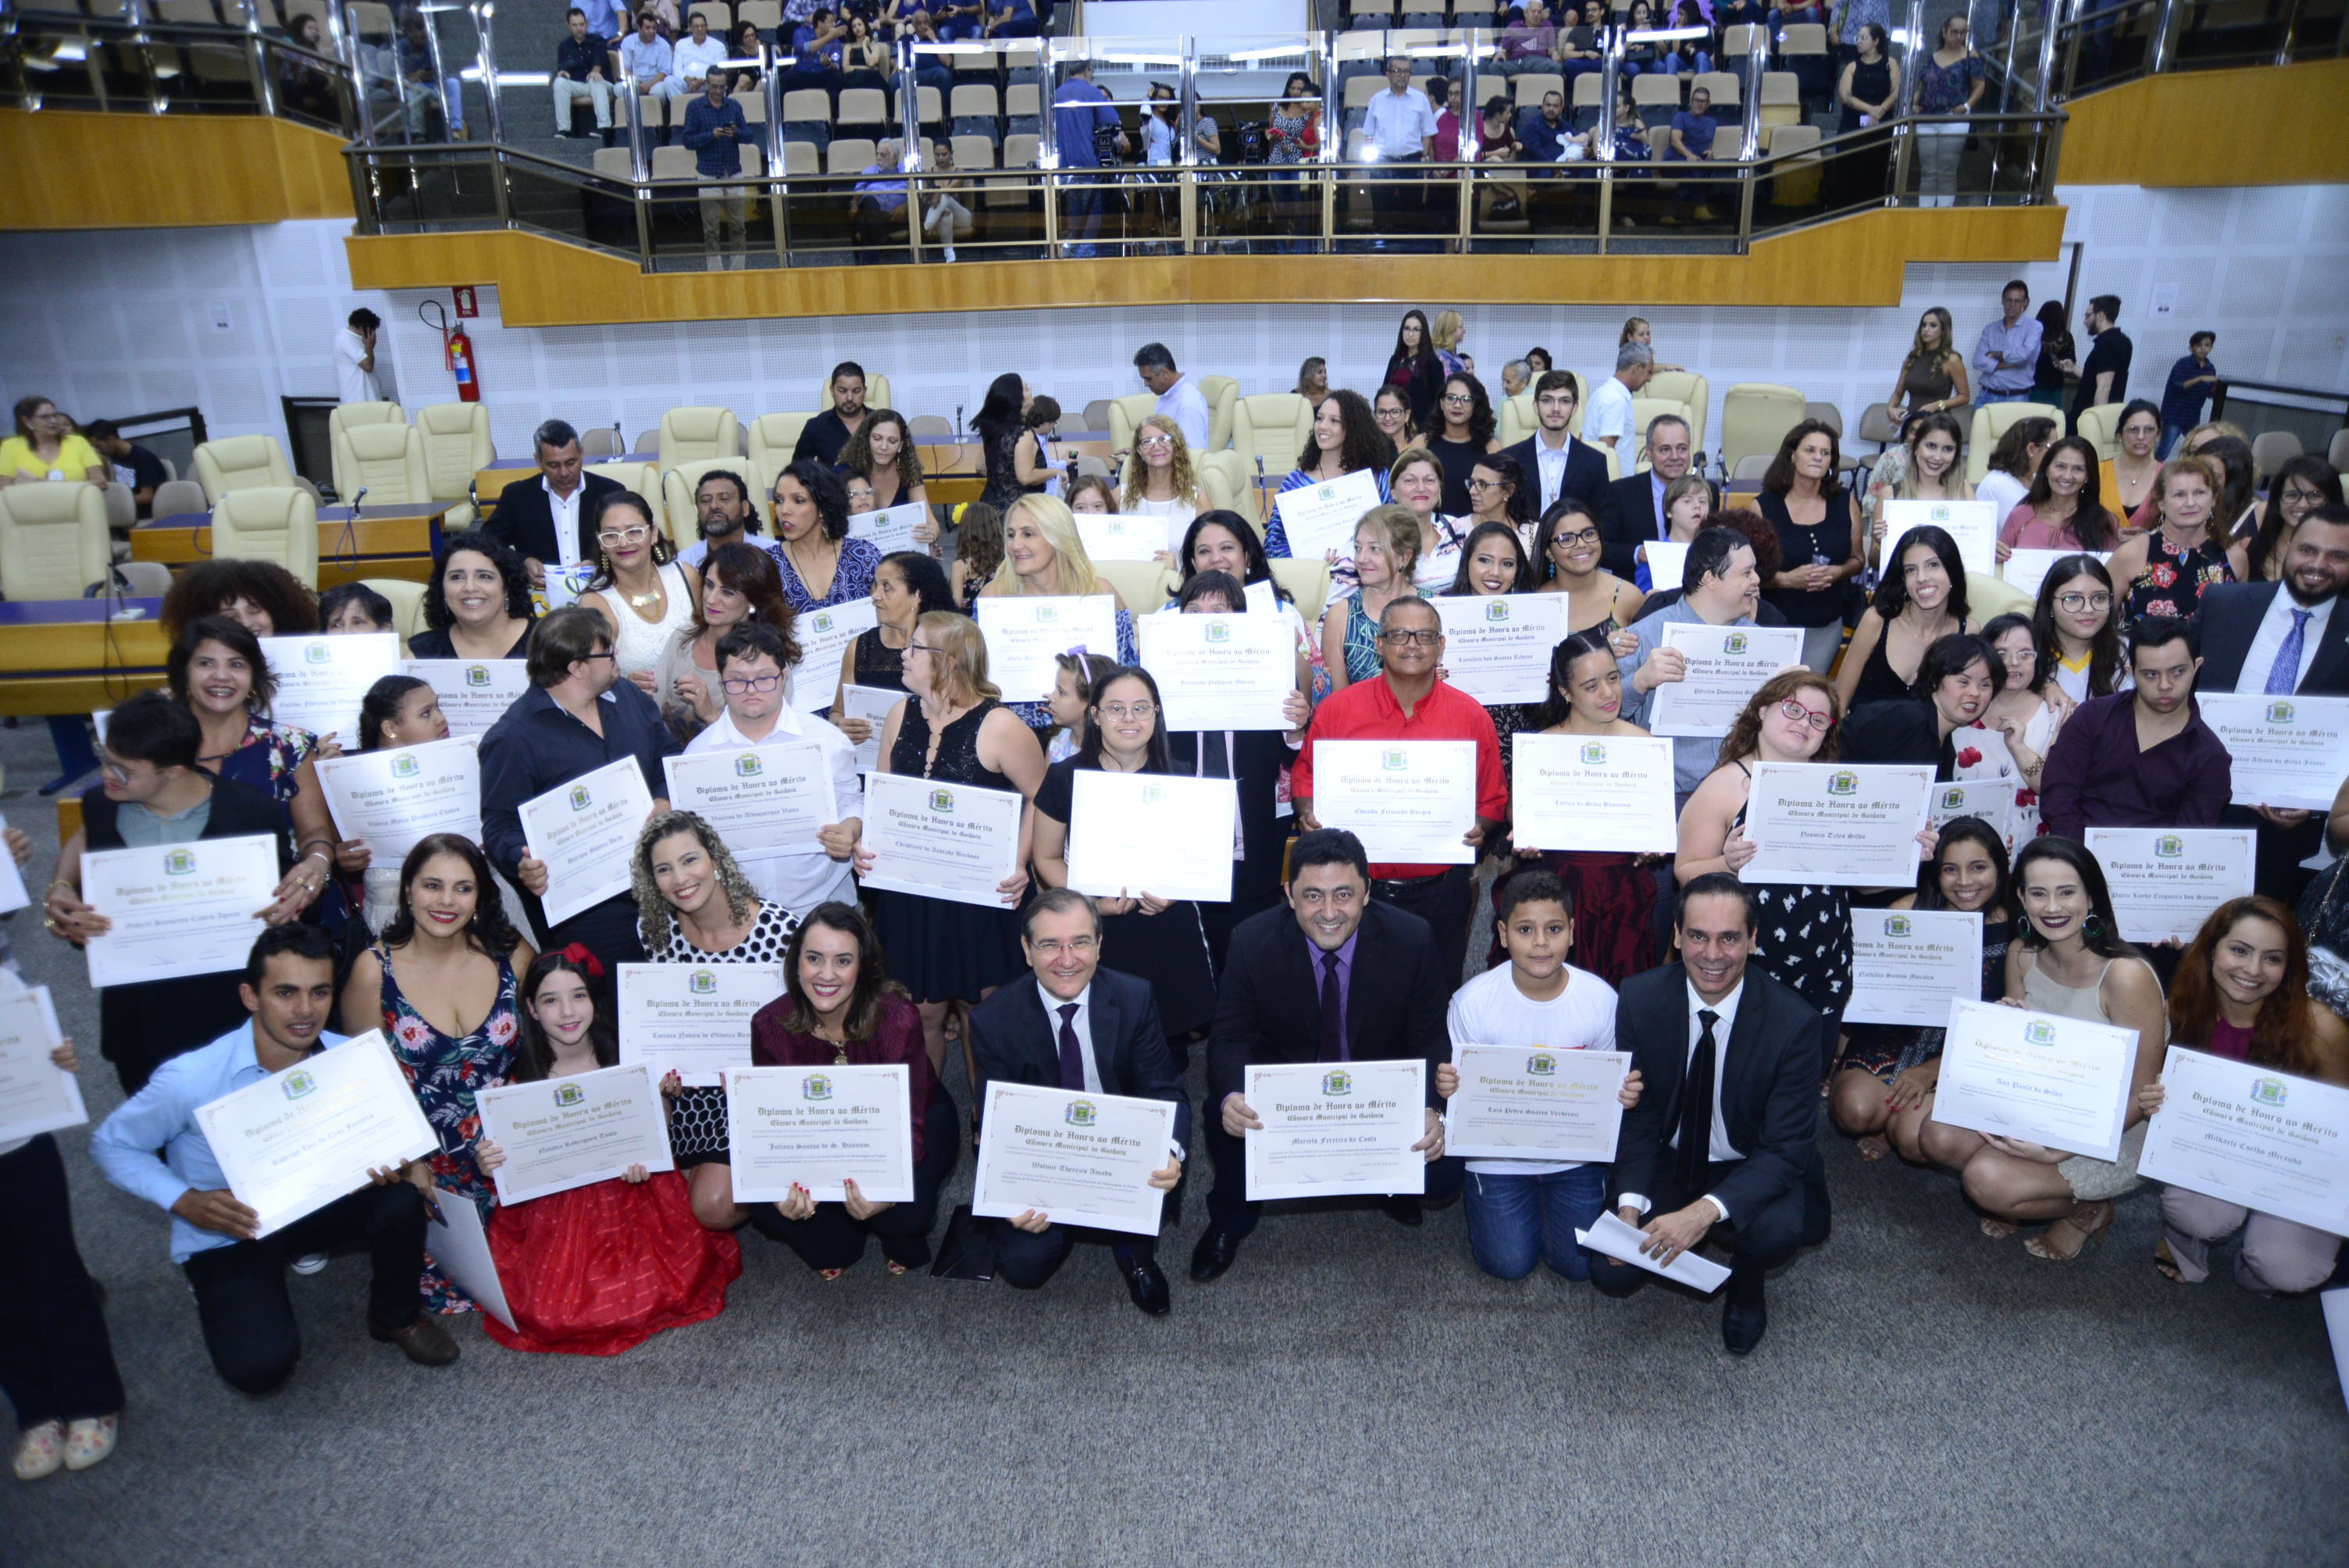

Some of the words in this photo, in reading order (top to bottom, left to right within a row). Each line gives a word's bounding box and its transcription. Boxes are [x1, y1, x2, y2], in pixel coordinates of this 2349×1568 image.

[1778, 799, 1813, 807] Diploma
[1829, 800, 1855, 809] Honra
[889, 809, 918, 820] Diploma
[931, 816, 954, 826] Honra
[757, 1107, 792, 1116] Diploma
[807, 1107, 835, 1115] Honra
[1276, 1103, 1310, 1112] Diploma
[562, 1110, 589, 1119] Honra
[2236, 1104, 2246, 1114] de
[2251, 1108, 2282, 1123] Honra
[1015, 1125, 1050, 1136] Diploma
[1068, 1131, 1094, 1142] Honra
